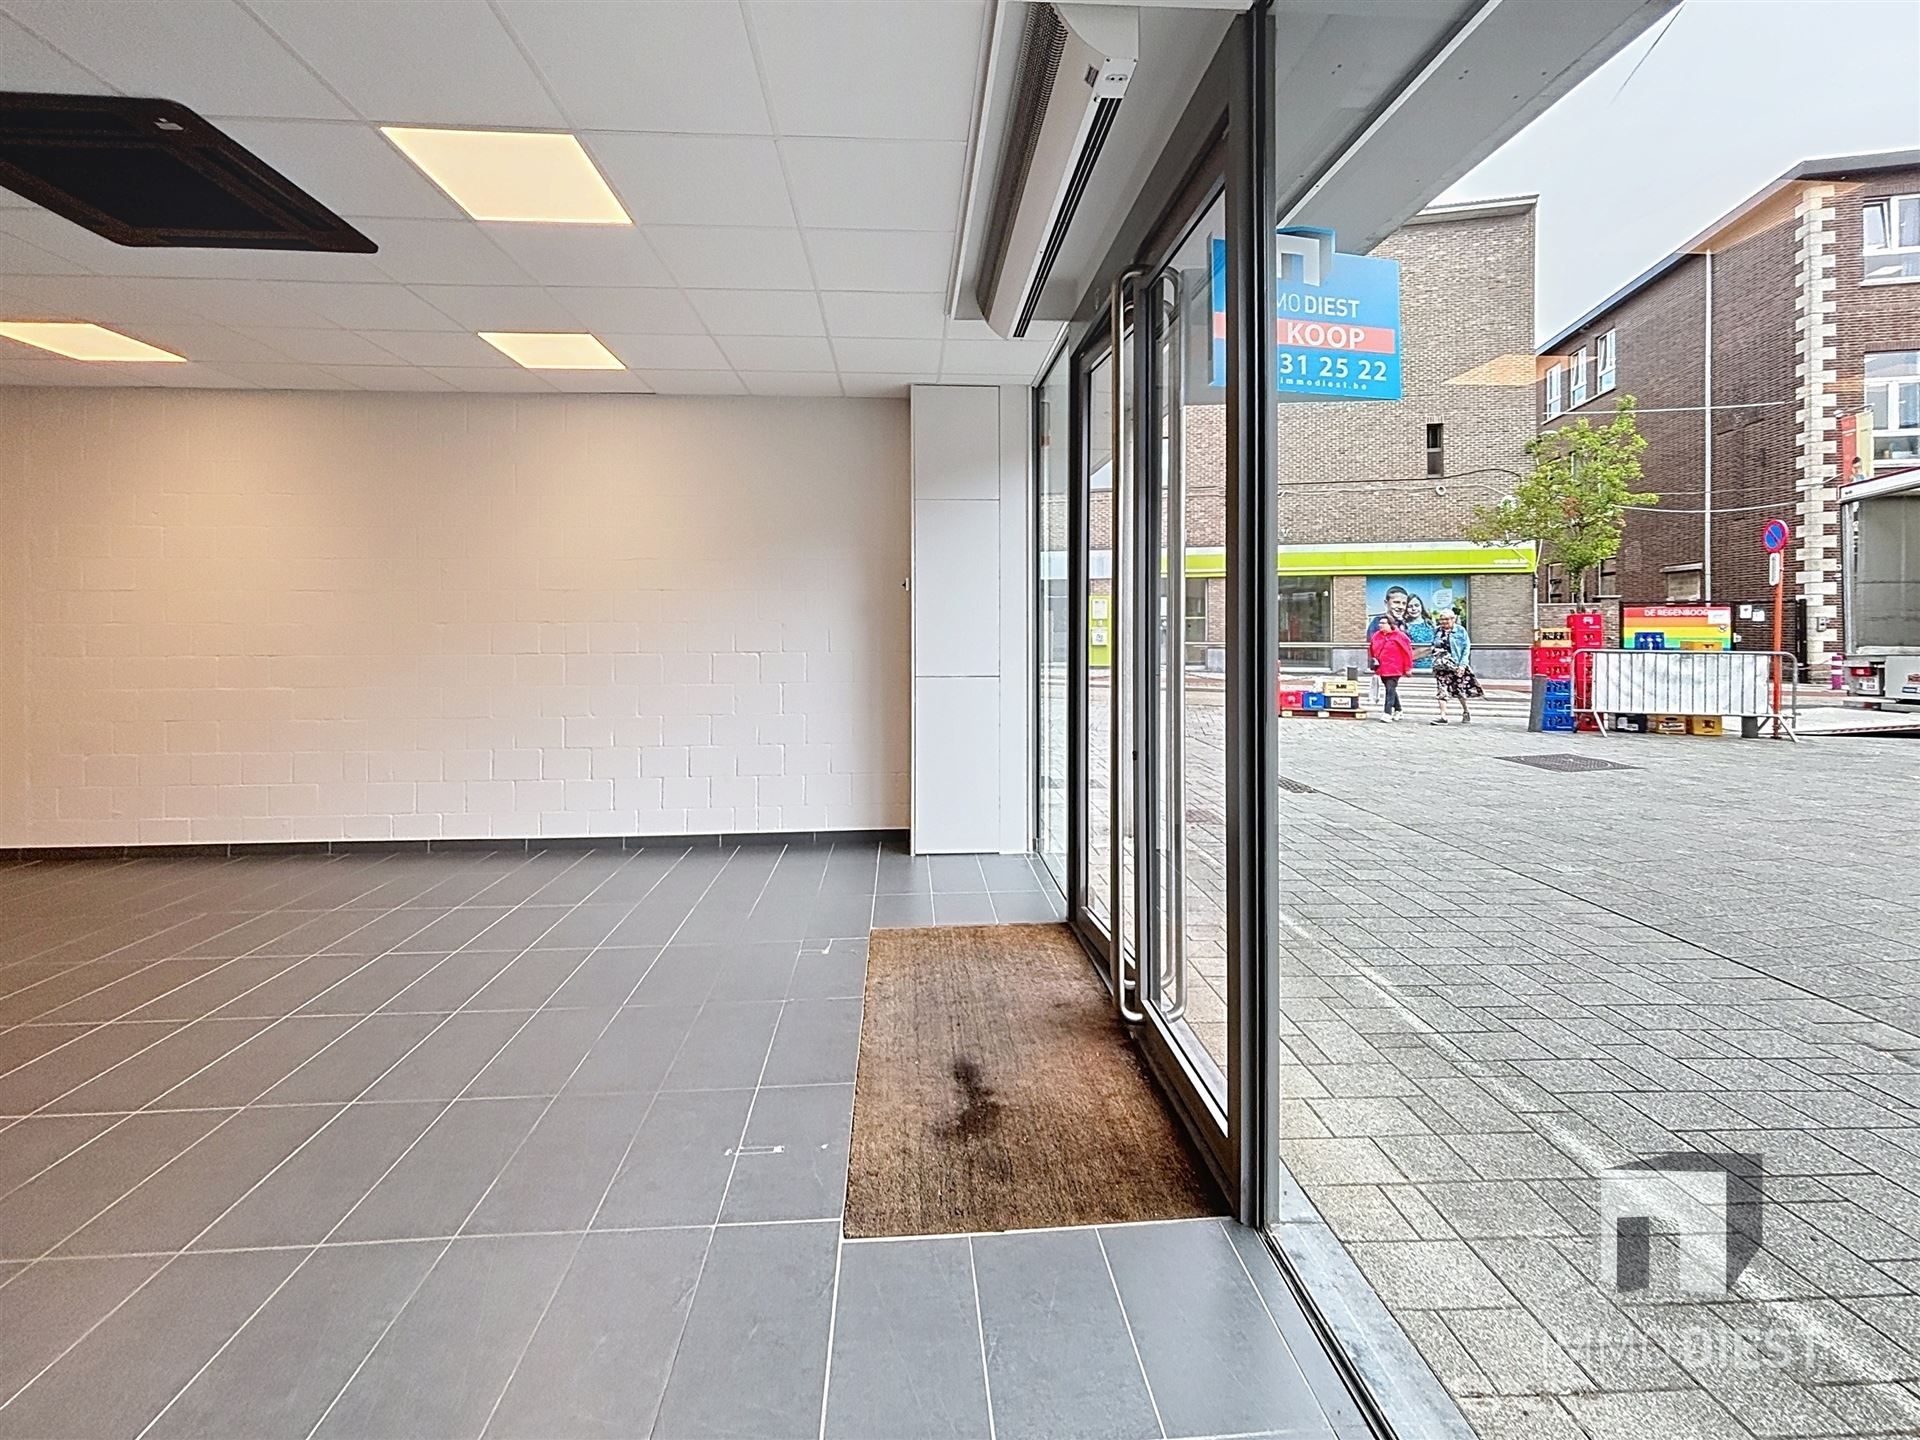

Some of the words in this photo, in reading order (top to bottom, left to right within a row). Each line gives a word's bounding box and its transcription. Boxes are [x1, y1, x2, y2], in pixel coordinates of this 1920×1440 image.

[1277, 293, 1300, 312] MO
[1304, 295, 1360, 318] DIEST
[1287, 322, 1365, 349] KOOP
[1279, 353, 1307, 375] 31
[1319, 357, 1348, 378] 25
[1358, 360, 1387, 381] 22
